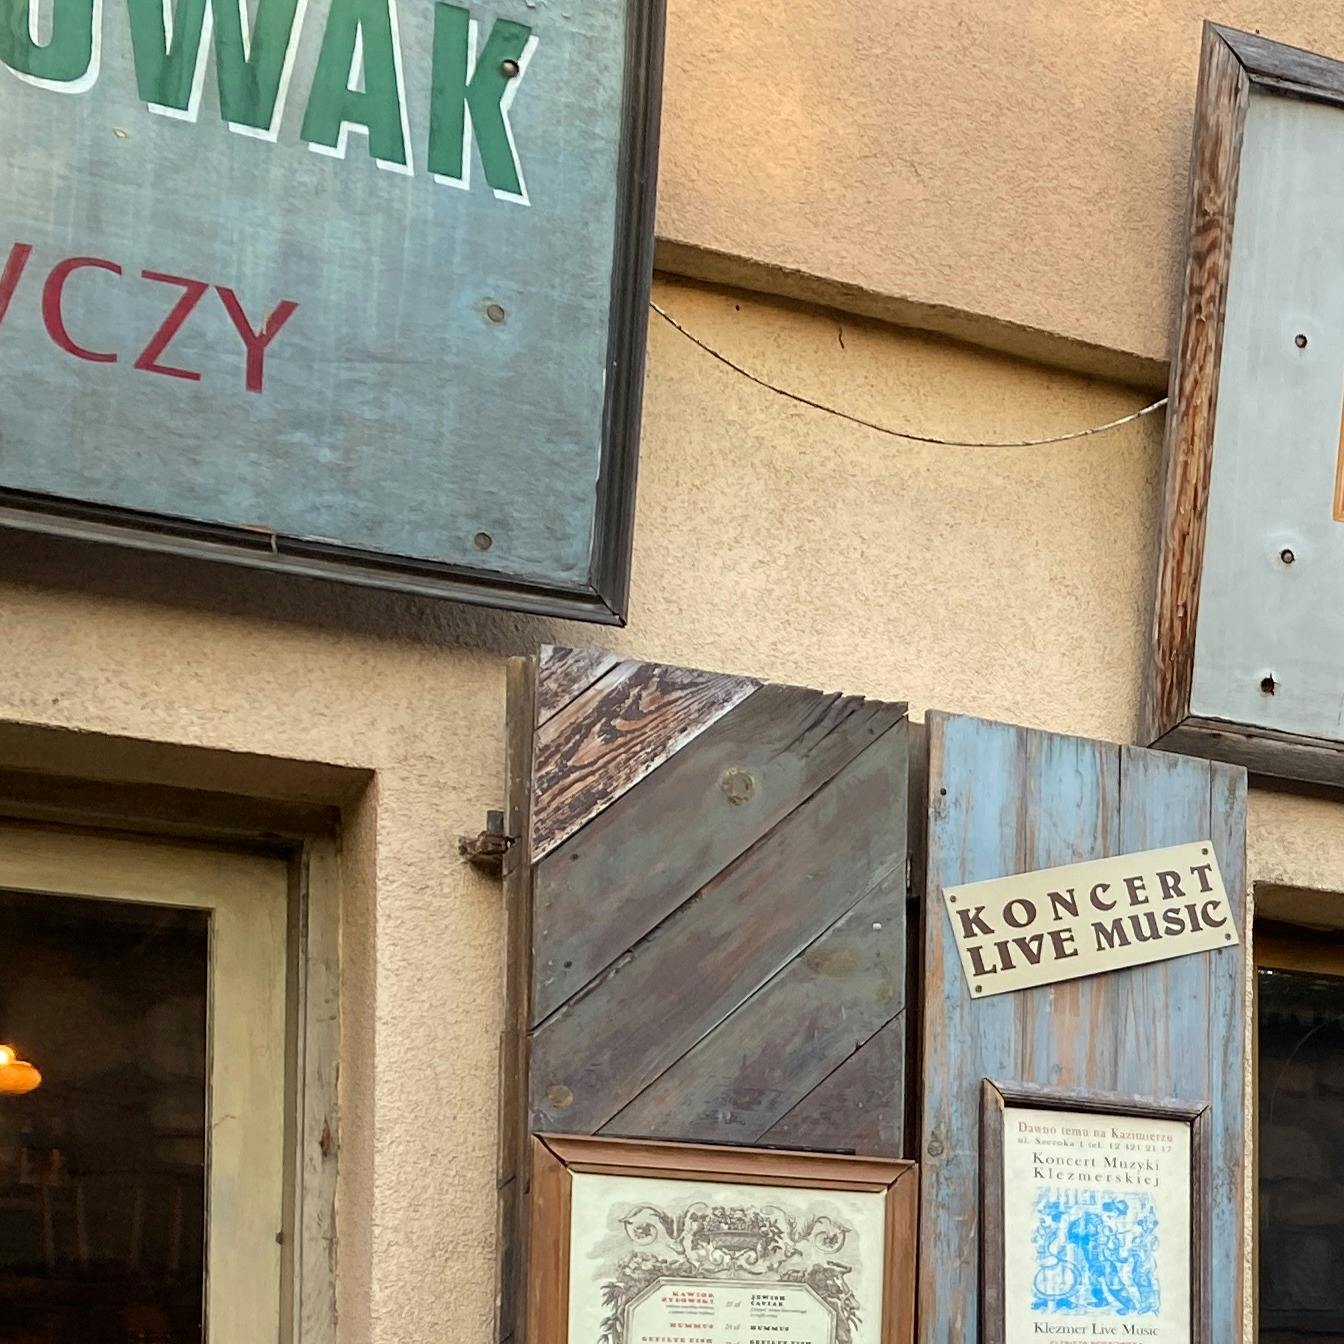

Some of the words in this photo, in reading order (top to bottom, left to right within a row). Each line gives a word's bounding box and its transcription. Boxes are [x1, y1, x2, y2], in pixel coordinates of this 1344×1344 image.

[0, 243, 300, 394] CZY
[955, 864, 1214, 939] KONCERT
[966, 928, 1079, 977] LIVE
[1091, 900, 1228, 952] MUSIC
[1018, 1121, 1057, 1135] Dawno
[1061, 1125, 1089, 1137] temu
[1093, 1129, 1106, 1138] na
[1111, 1128, 1173, 1142] Kazimierzu
[1032, 1151, 1096, 1168] Koncert
[1103, 1156, 1160, 1172] Muzyki
[1033, 1166, 1160, 1187] Klezmerskiej
[1033, 1321, 1088, 1335] Klezmer
[1092, 1322, 1117, 1336] Live
[1121, 1323, 1160, 1336] Music
